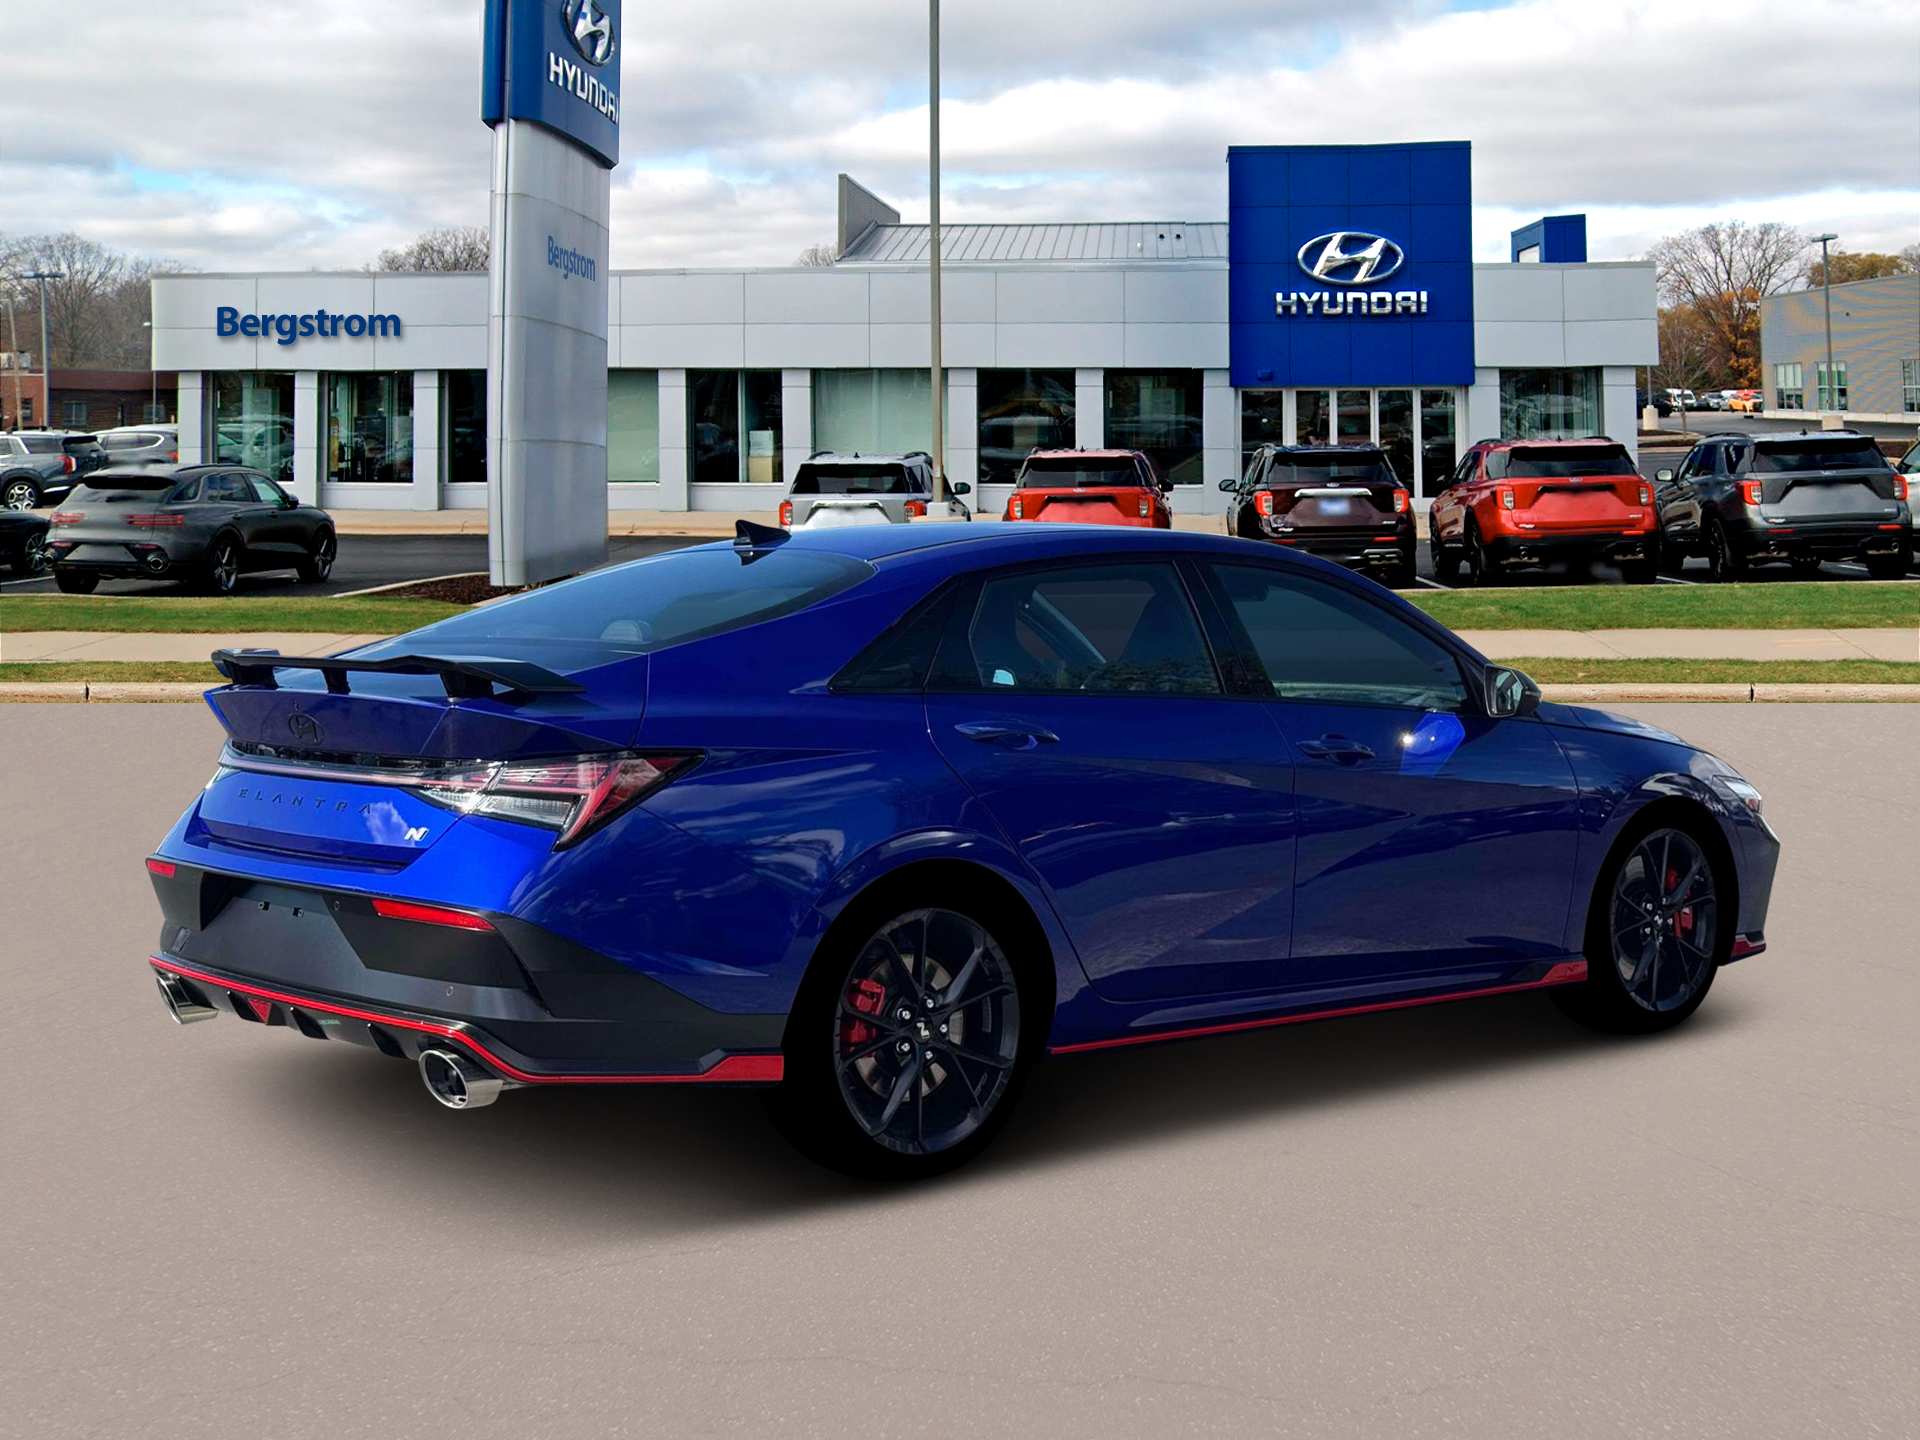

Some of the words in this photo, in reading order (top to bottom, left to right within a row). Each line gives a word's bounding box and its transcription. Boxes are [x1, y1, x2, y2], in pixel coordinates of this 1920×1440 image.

[549, 52, 619, 124] HYUNDAI
[548, 235, 596, 282] Bergstrom
[1275, 291, 1428, 315] HYUNDAI
[216, 306, 402, 346] Bergstrom
[238, 788, 372, 815] ELANTRA
